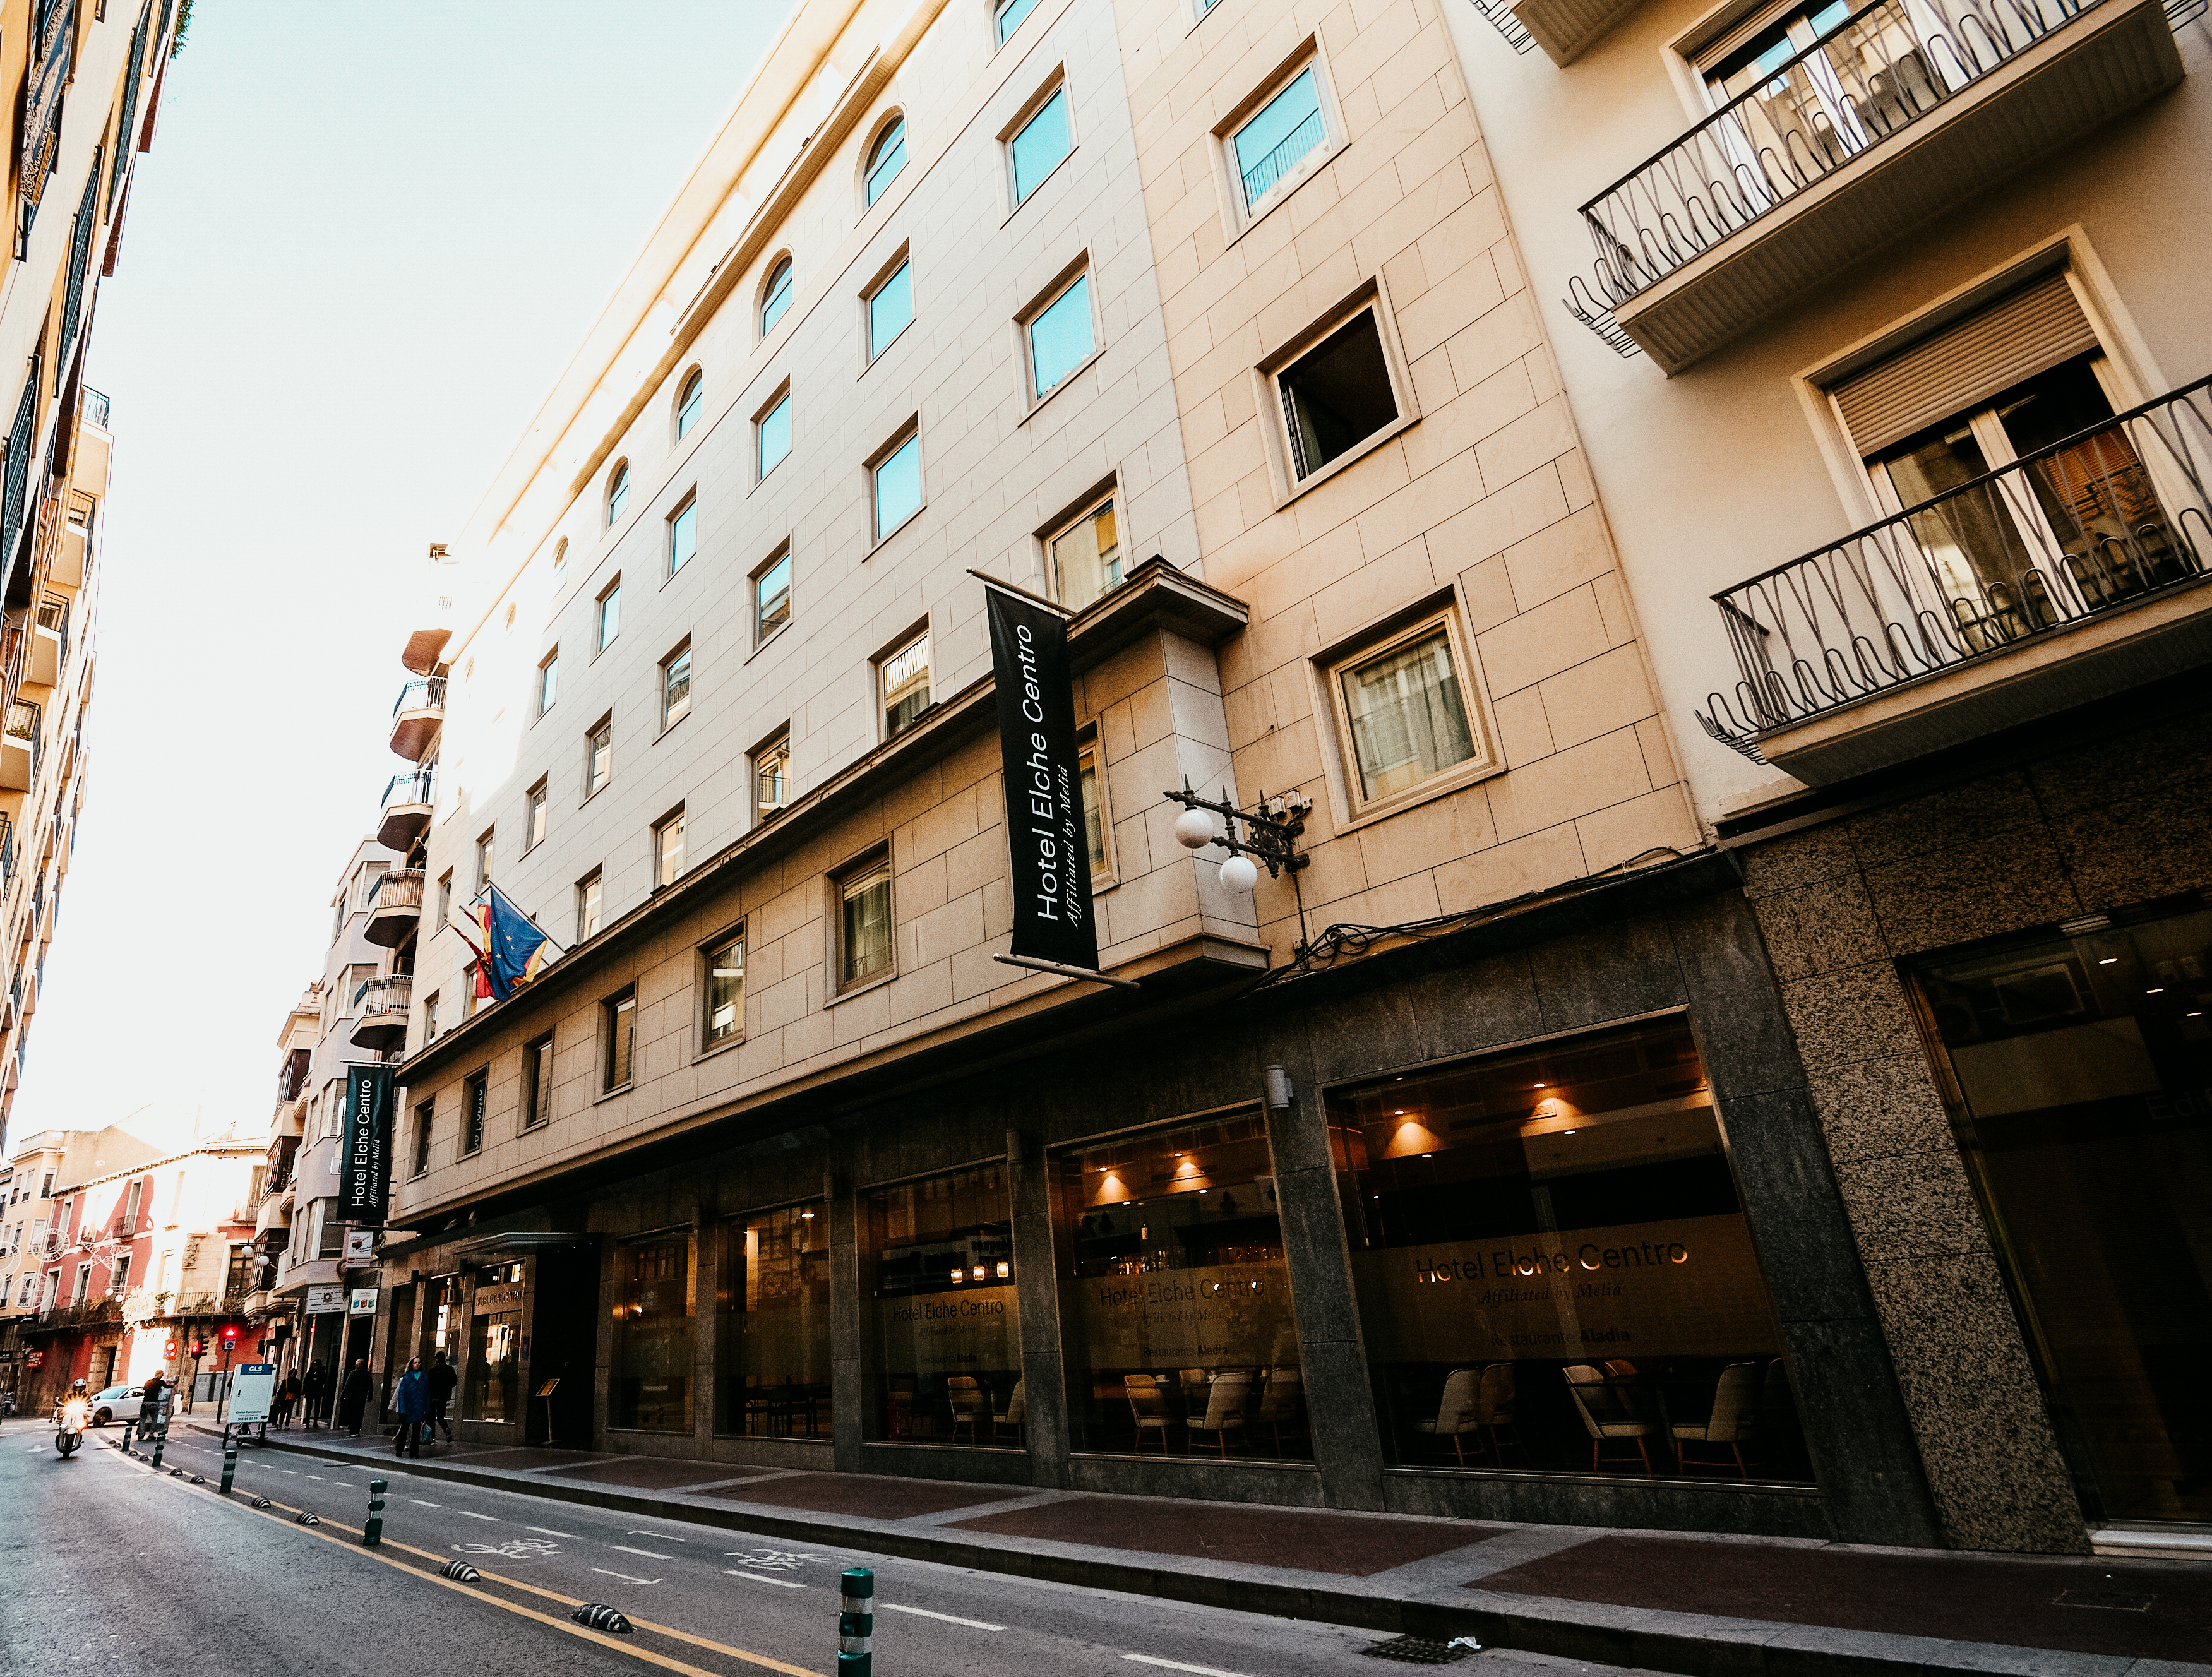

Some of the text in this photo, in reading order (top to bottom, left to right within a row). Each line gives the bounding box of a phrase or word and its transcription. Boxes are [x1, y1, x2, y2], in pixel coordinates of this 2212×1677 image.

[1017, 624, 1058, 921] Hotel Elche Centro
[1058, 764, 1082, 929] Affiliated by Meliá
[351, 1080, 371, 1207] Hotel Elche Centro
[369, 1139, 381, 1207] Affiliated by Meliá
[1416, 1240, 1687, 1283] Hotel Elche Centro
[1100, 1279, 1265, 1306] Hotel Elche Centro
[1480, 1286, 1550, 1308] Affiliated
[1555, 1284, 1570, 1301] by
[893, 1299, 1003, 1323] Hotel Elche Centro
[1144, 1346, 1194, 1358] Restaurante
[1491, 1328, 1631, 1347] Restaurante Aladia
